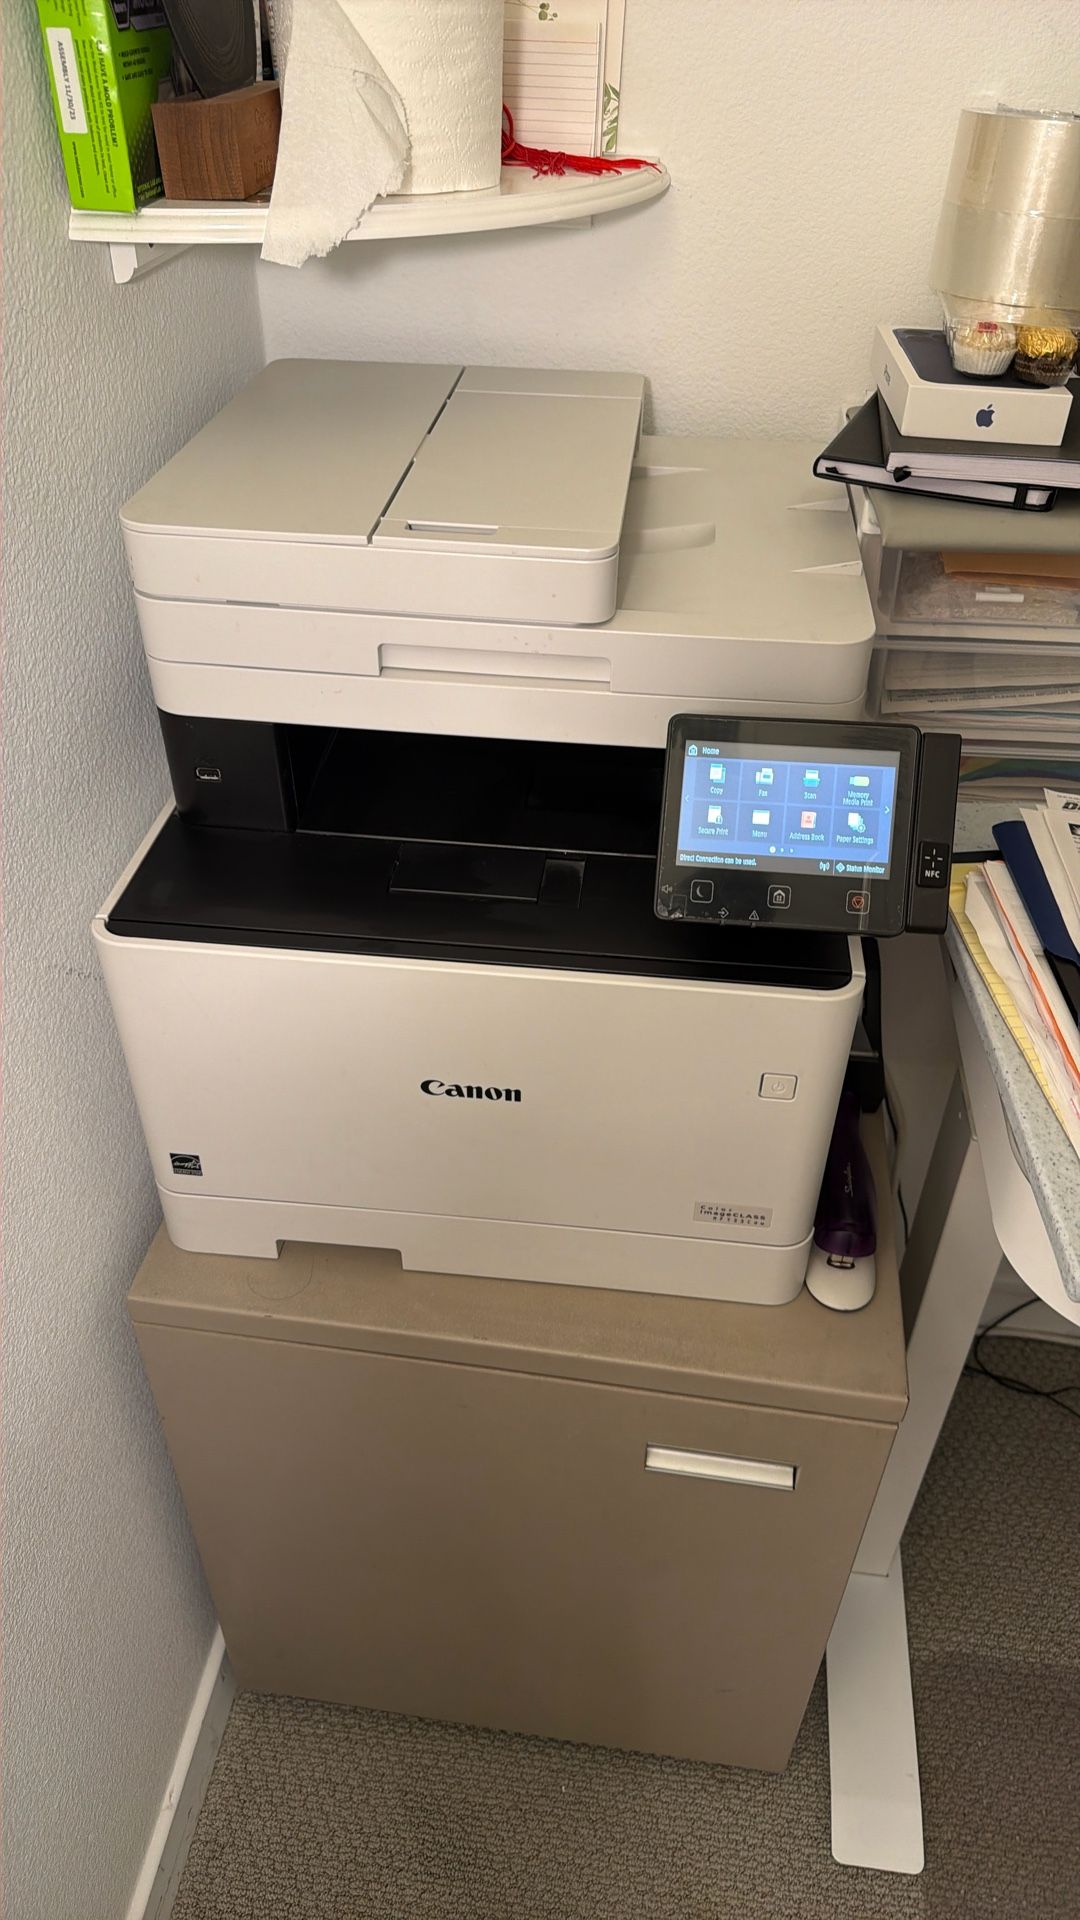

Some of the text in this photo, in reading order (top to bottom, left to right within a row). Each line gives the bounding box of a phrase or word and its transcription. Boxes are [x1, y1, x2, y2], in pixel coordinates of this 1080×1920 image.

[97, 57, 108, 76] HAVE
[58, 40, 77, 120] ASSEMBLY 11/30/23
[102, 86, 112, 108] MOLD
[106, 108, 118, 147] PROBLEM?
[702, 746, 720, 756] Home
[710, 786, 724, 796] Copy
[758, 789, 768, 798] Fax
[803, 791, 817, 800] Scan
[847, 790, 870, 799] Memory
[842, 797, 874, 807] Media Print
[698, 826, 729, 836] Secure Print
[752, 829, 768, 839] Menu
[789, 832, 825, 842] Address Book
[836, 834, 874, 846] Paper Settings
[680, 853, 695, 862] Direct
[695, 854, 724, 864] Connection
[735, 857, 743, 865] be
[743, 858, 757, 866] used.
[846, 863, 885, 874] Status Monitor
[924, 868, 940, 879] NFC
[420, 1079, 522, 1103] Canon
